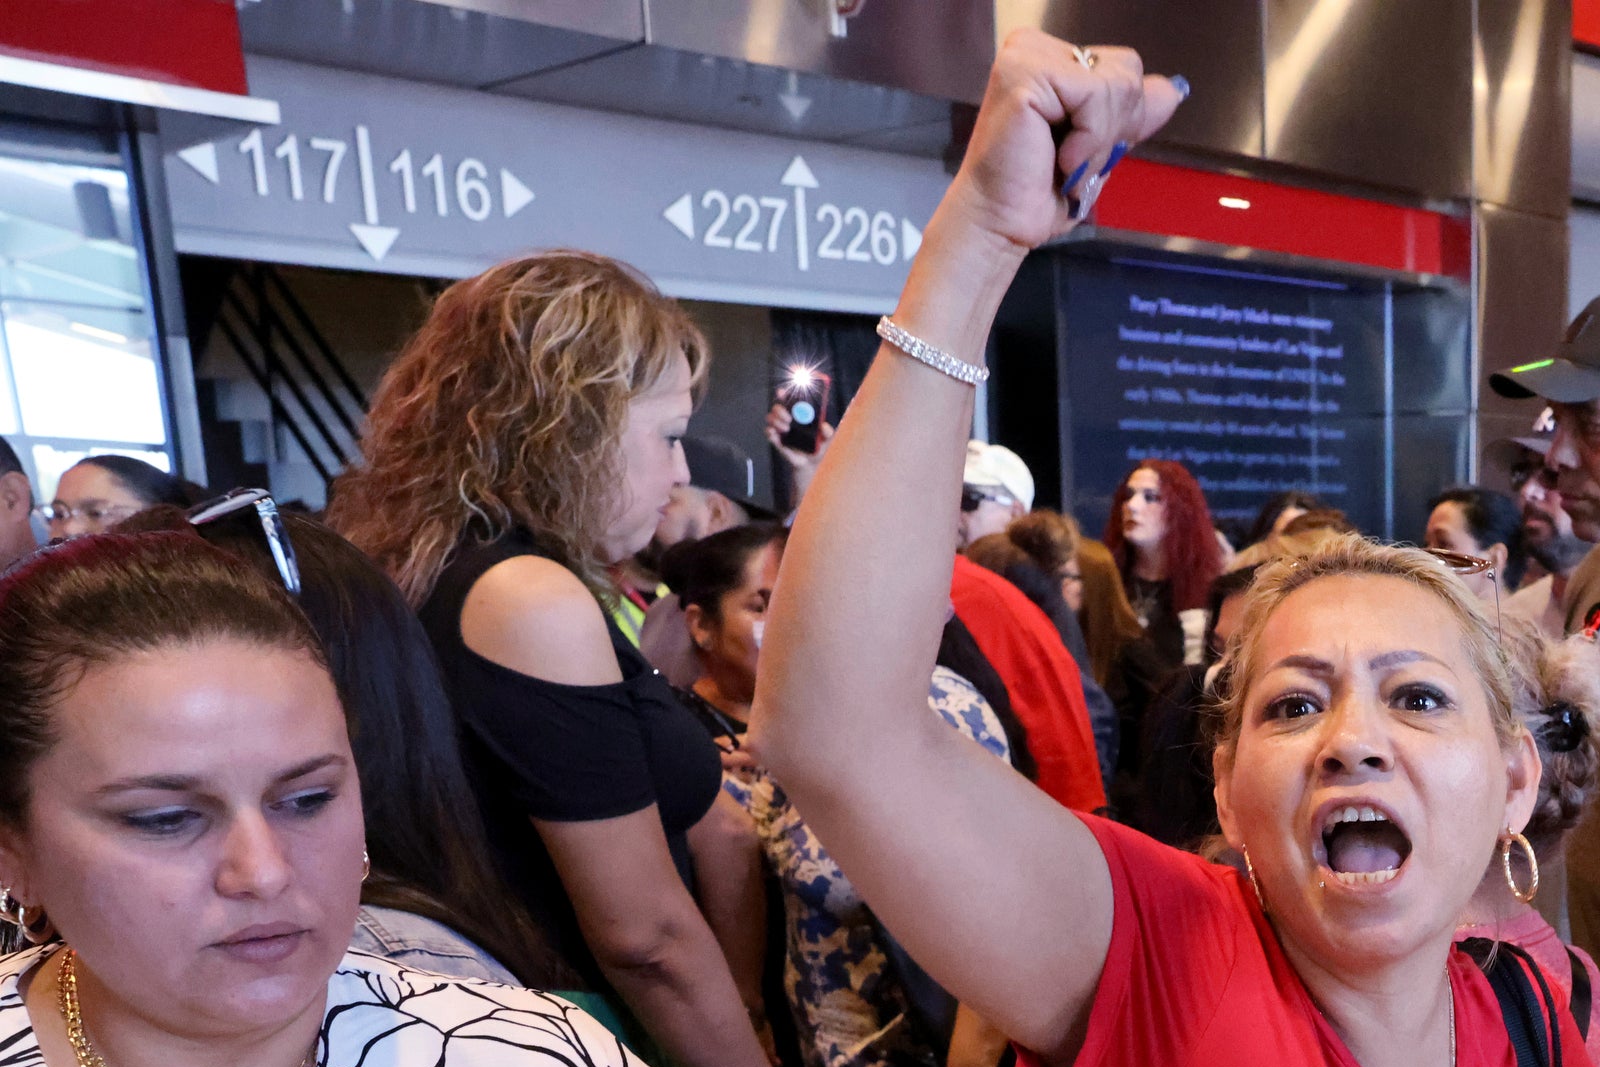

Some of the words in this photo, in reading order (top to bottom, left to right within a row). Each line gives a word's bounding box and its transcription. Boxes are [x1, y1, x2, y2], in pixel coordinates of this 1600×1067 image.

[239, 130, 346, 202] 117
[391, 148, 491, 221] 116
[703, 190, 787, 254] 227
[816, 203, 898, 266] 226
